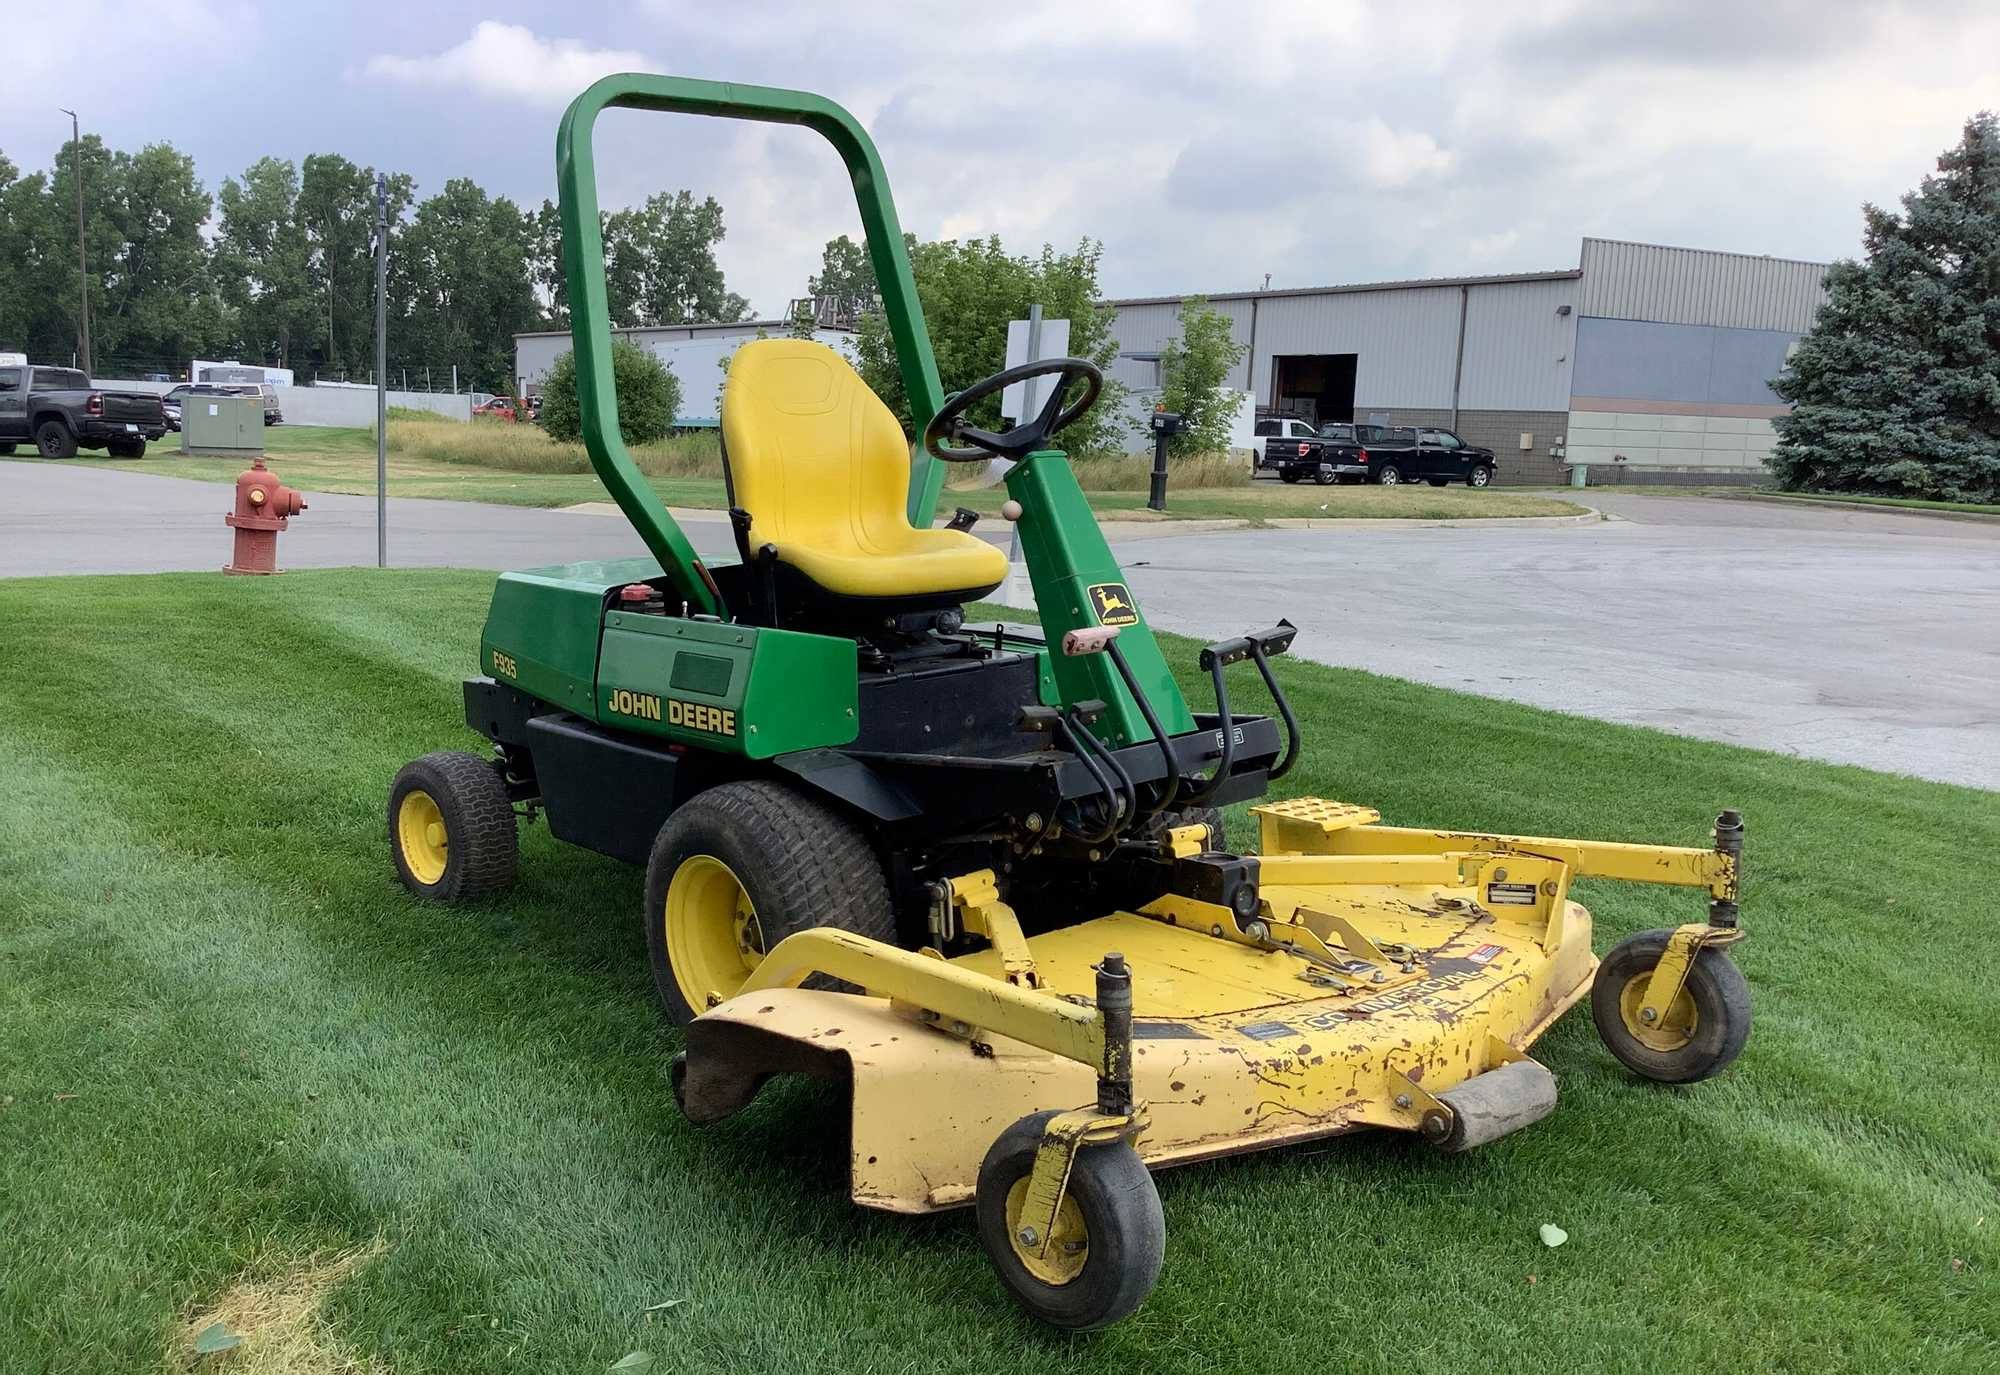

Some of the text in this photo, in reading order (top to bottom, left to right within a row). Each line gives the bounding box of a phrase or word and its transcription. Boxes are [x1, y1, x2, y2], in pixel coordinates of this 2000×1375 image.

[1102, 615, 1136, 625] JOHN DEERE
[493, 649, 518, 680] F935
[608, 688, 736, 736] JOHN DEERE
